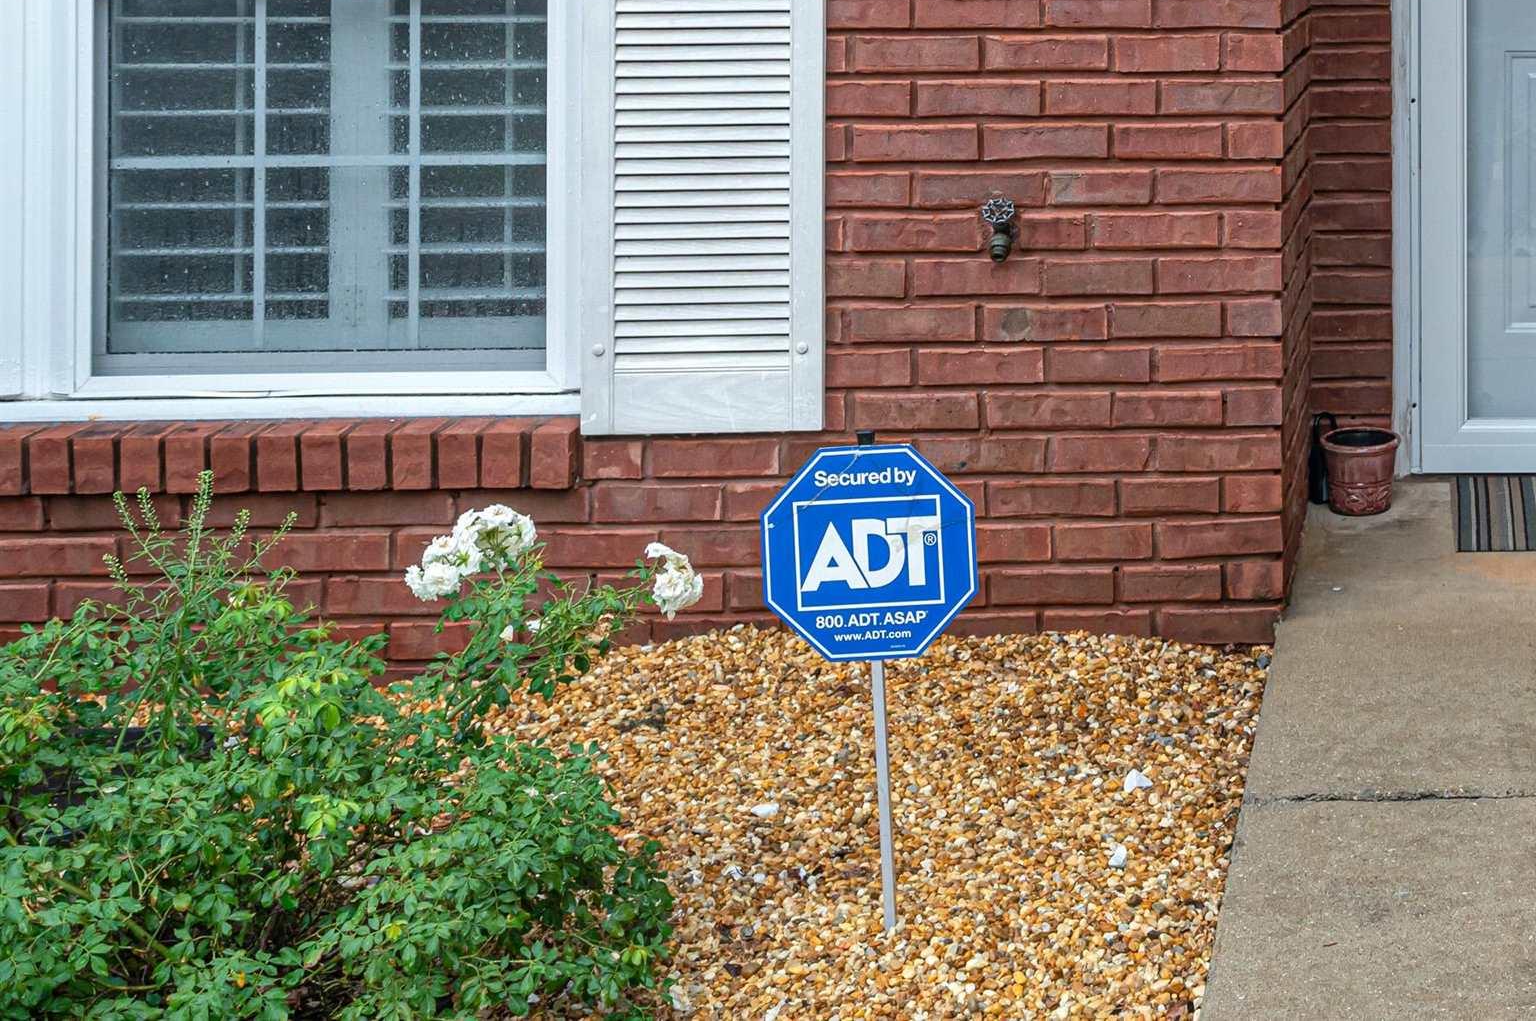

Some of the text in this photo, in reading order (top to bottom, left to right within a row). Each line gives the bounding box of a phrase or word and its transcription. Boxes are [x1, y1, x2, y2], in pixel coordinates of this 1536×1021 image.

[814, 467, 916, 487] Secured by
[800, 515, 938, 592] ADT
[815, 611, 926, 629] 800.ADT.ASAP
[834, 629, 912, 642] www.ADT.com
